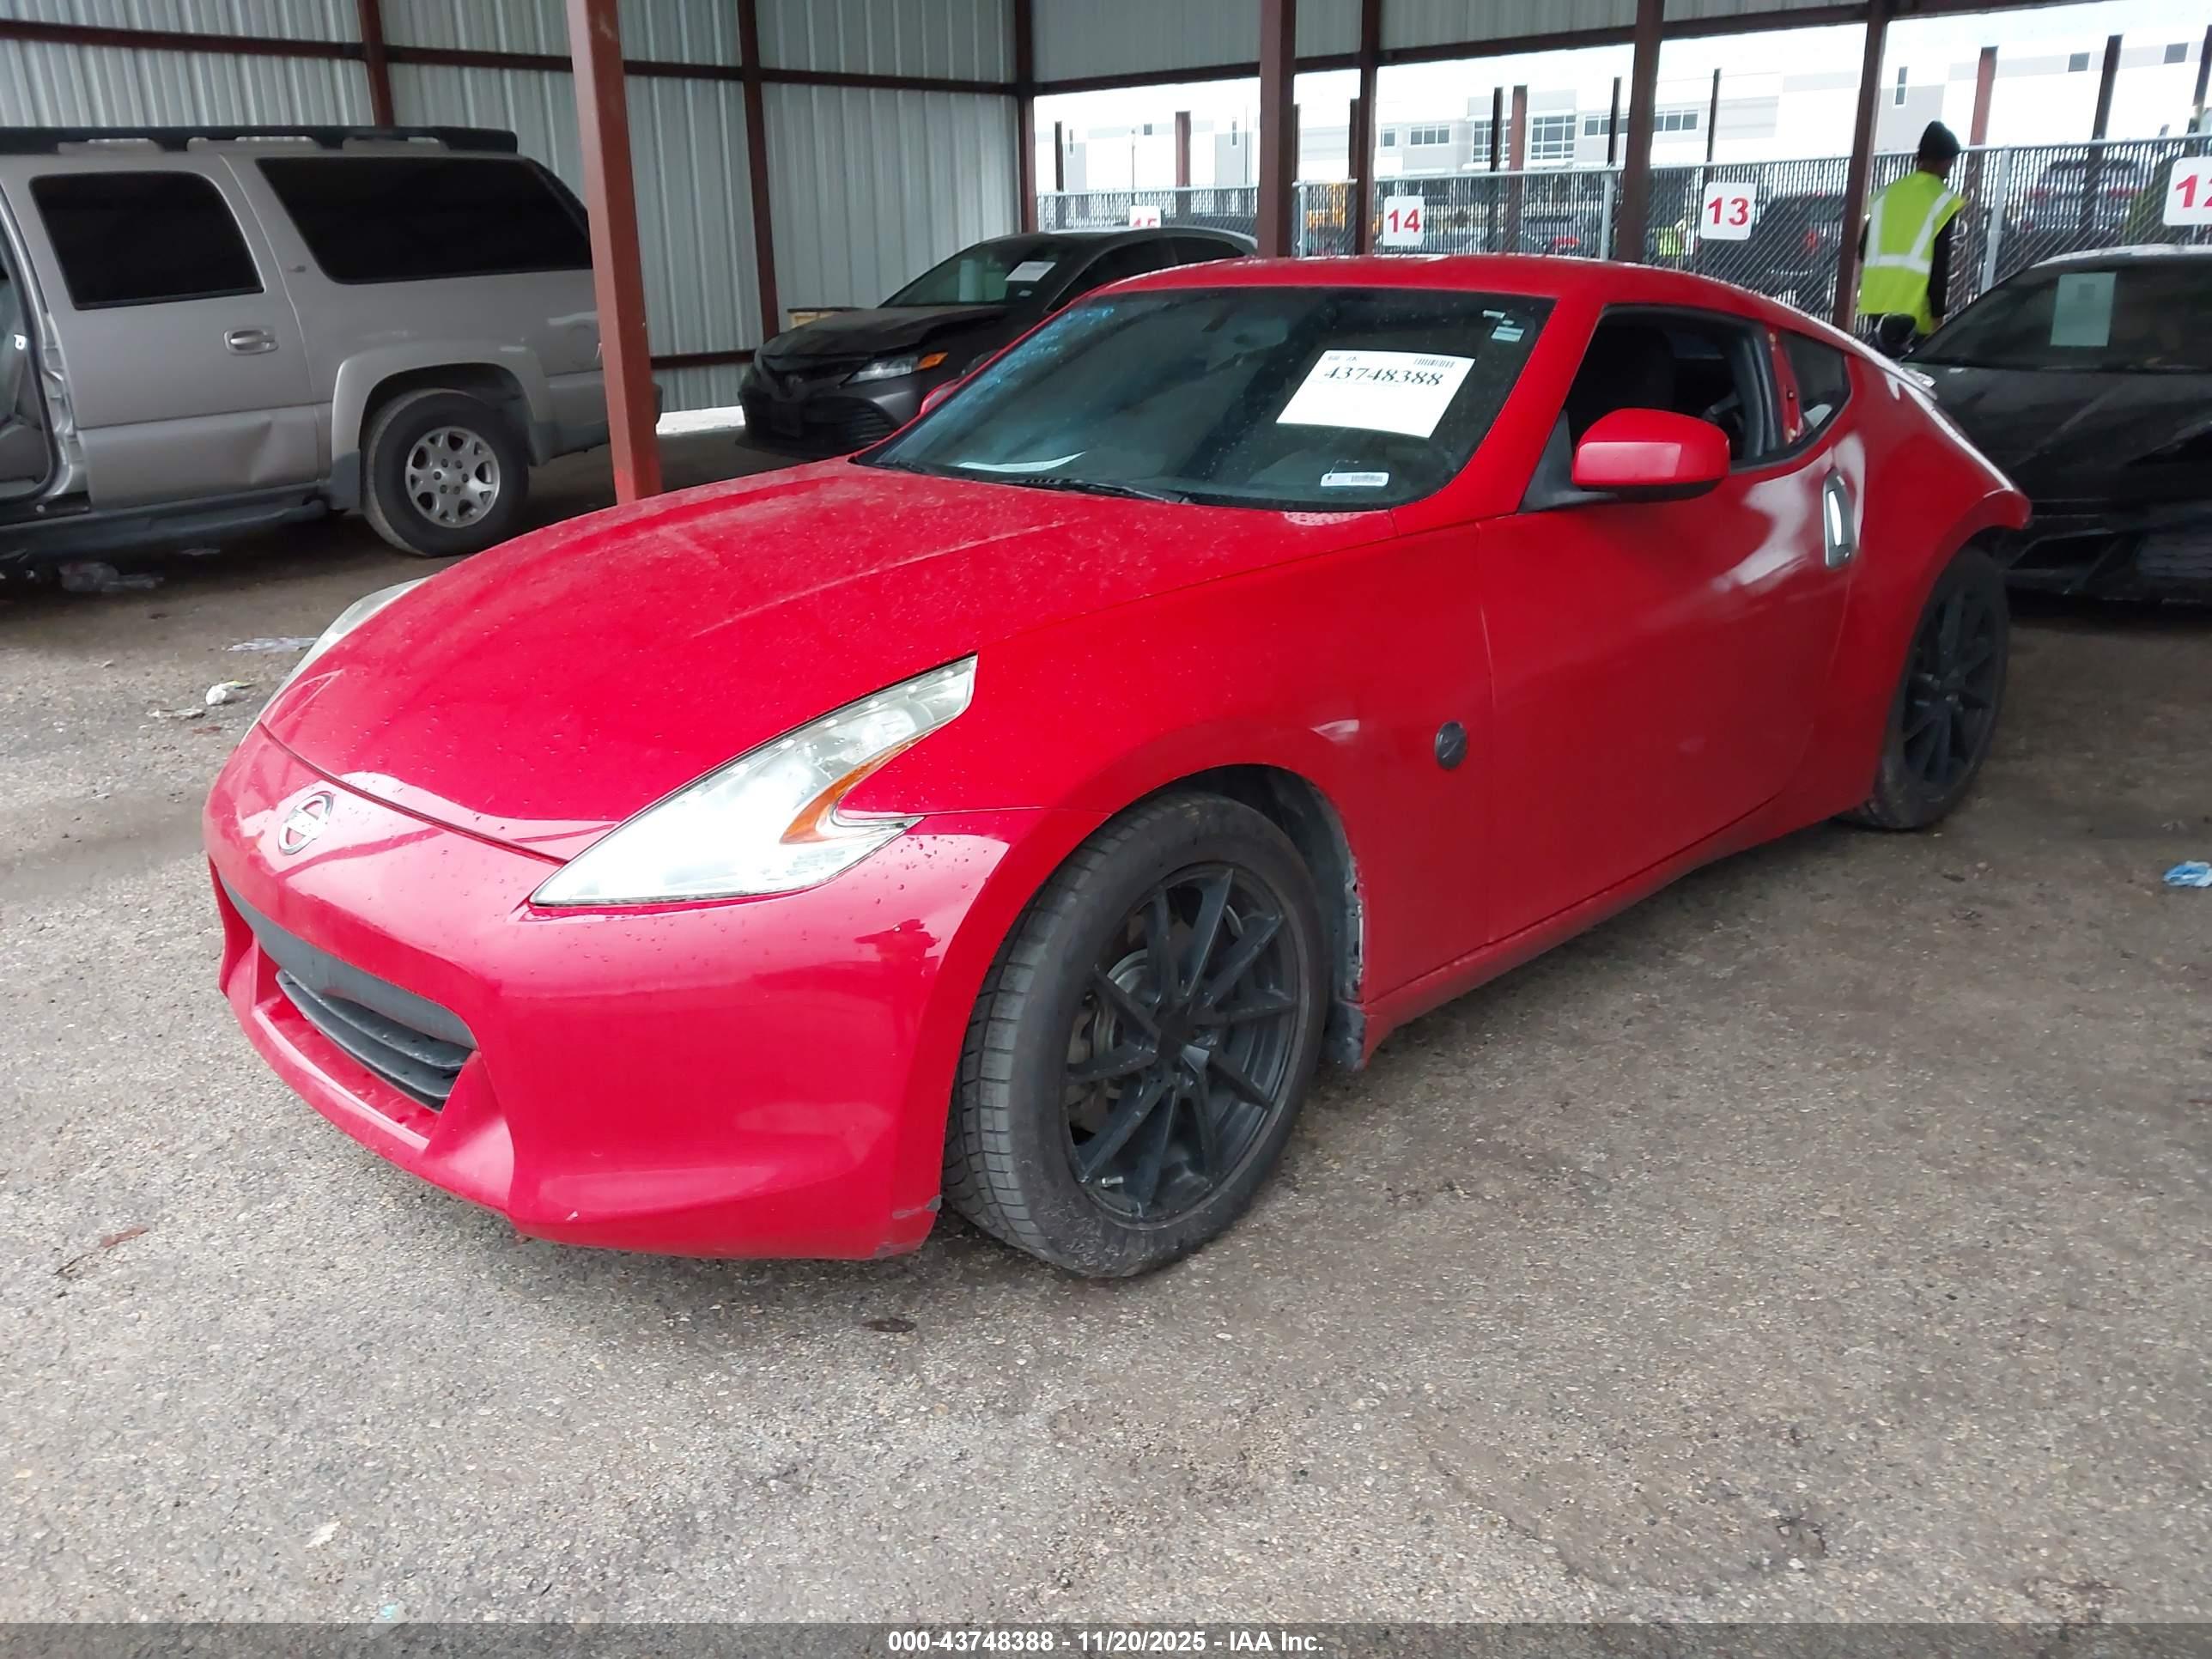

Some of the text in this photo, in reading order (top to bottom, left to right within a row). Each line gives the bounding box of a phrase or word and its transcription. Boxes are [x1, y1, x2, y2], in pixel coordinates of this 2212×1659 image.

[1388, 209, 1421, 233] 14
[1708, 197, 1749, 226] 13
[1323, 366, 1443, 386] 43748388
